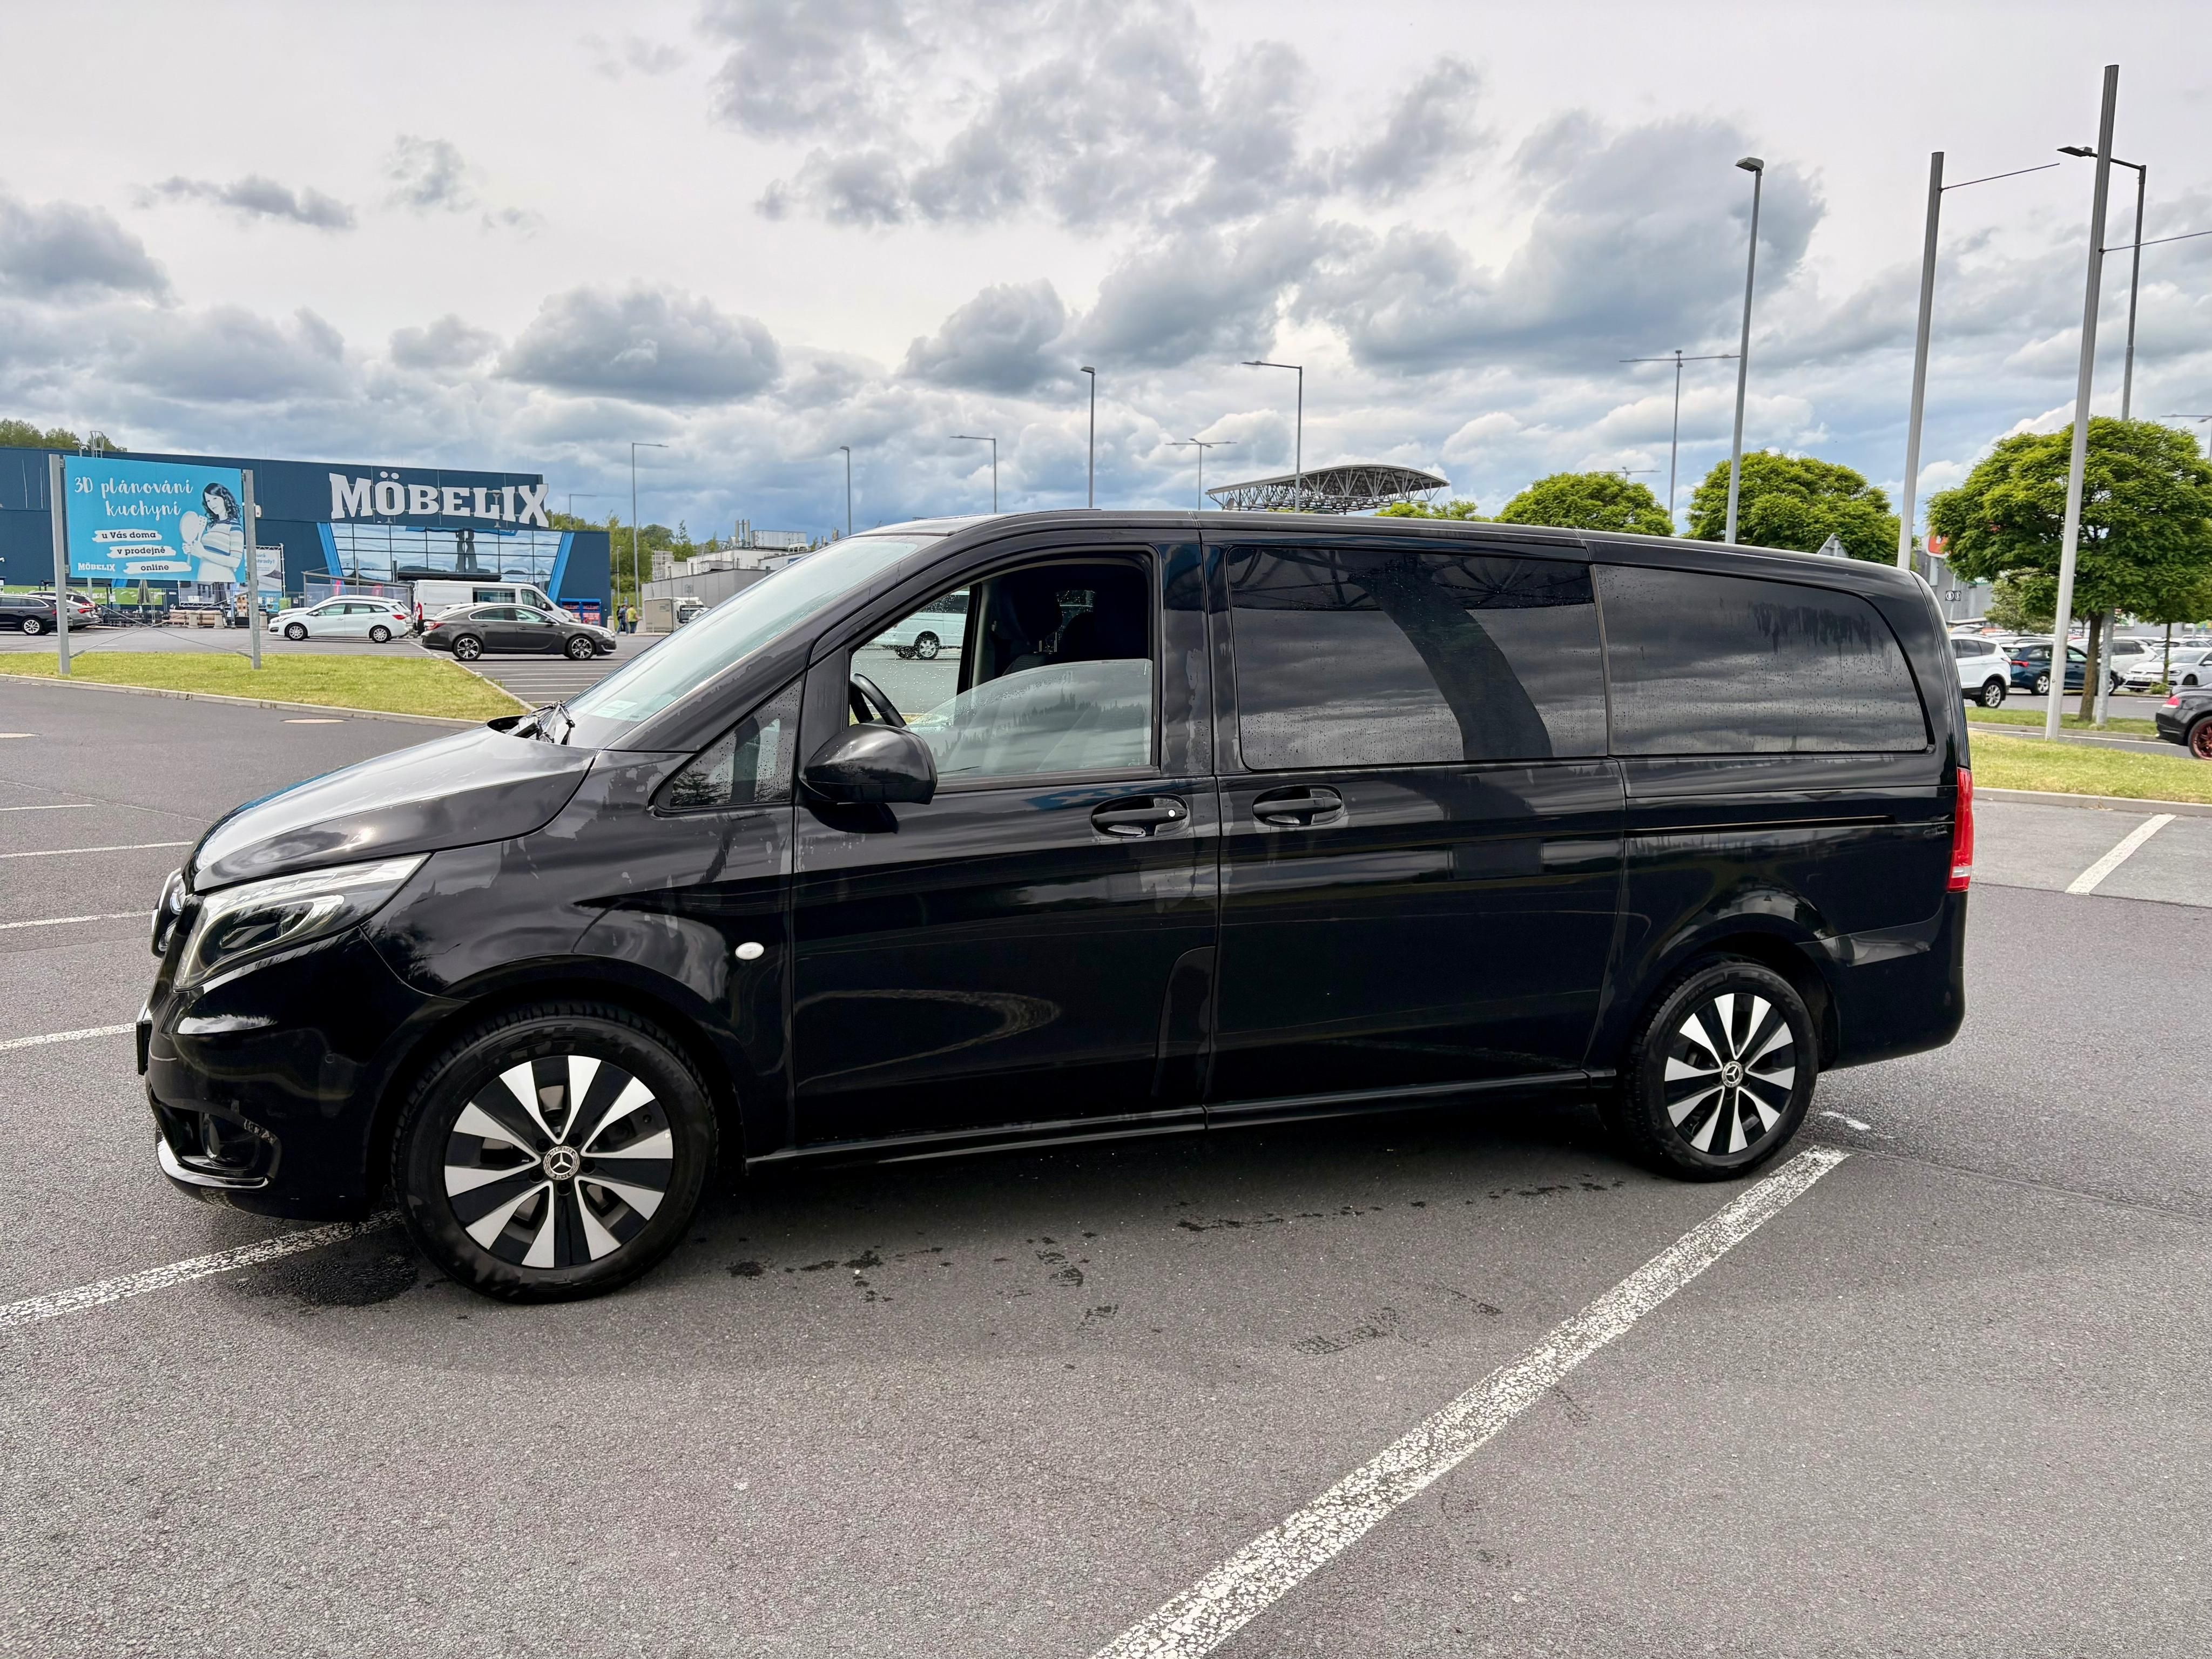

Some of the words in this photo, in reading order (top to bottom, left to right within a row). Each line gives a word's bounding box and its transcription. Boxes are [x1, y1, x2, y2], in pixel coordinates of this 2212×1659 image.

[75, 477, 93, 493] 3D
[101, 477, 193, 498] plánování
[329, 471, 549, 528] MÖBELIX
[105, 500, 181, 521] kuchyní
[125, 546, 165, 556] prodejně
[78, 562, 115, 571] MÖBELIX
